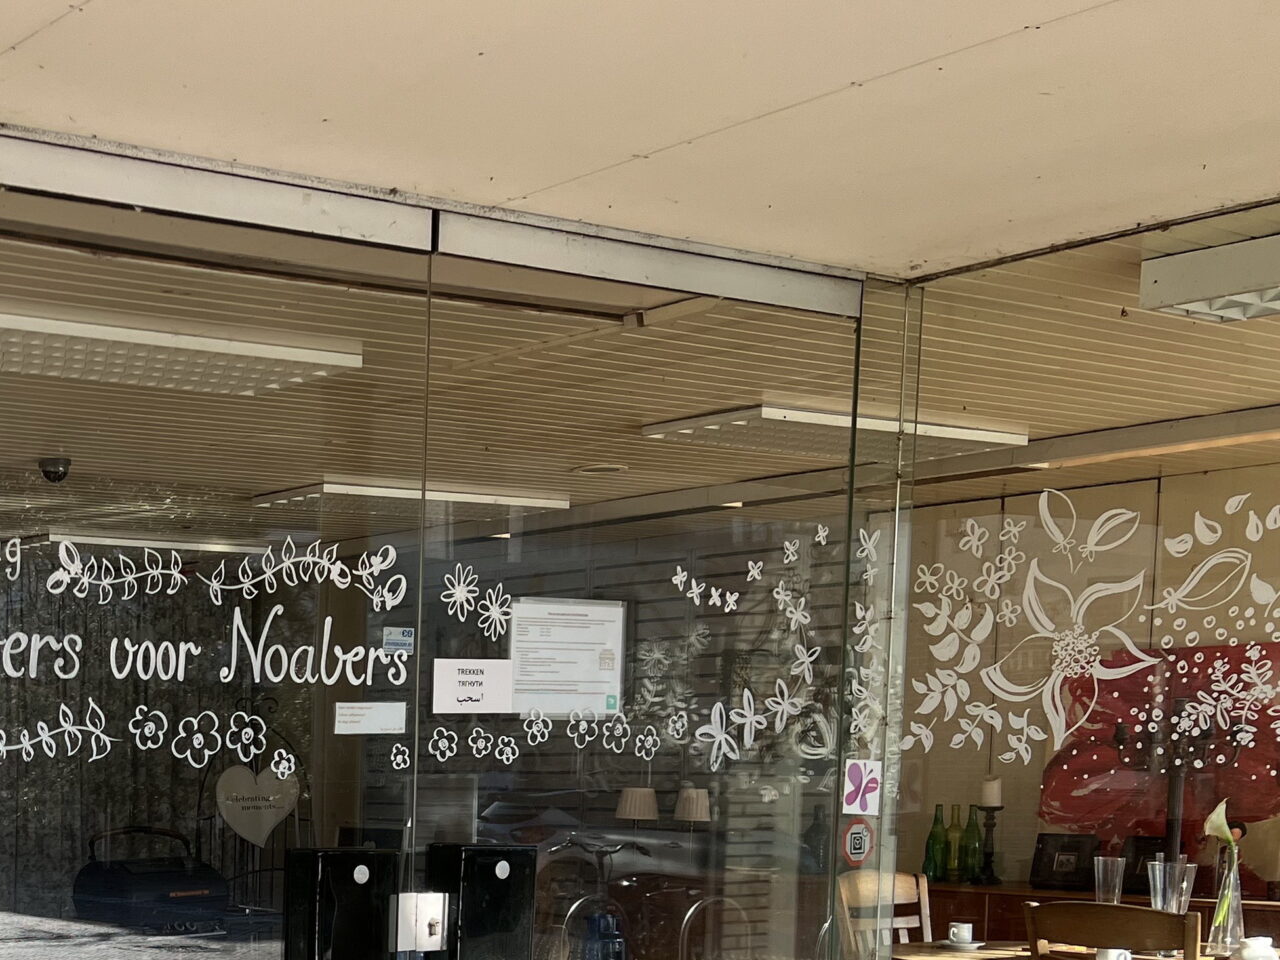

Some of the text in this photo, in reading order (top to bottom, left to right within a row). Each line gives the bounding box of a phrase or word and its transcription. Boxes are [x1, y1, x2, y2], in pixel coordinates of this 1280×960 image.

[109, 637, 202, 682] voor
[220, 604, 407, 685] Noabers
[457, 668, 485, 676] TREKKEN
